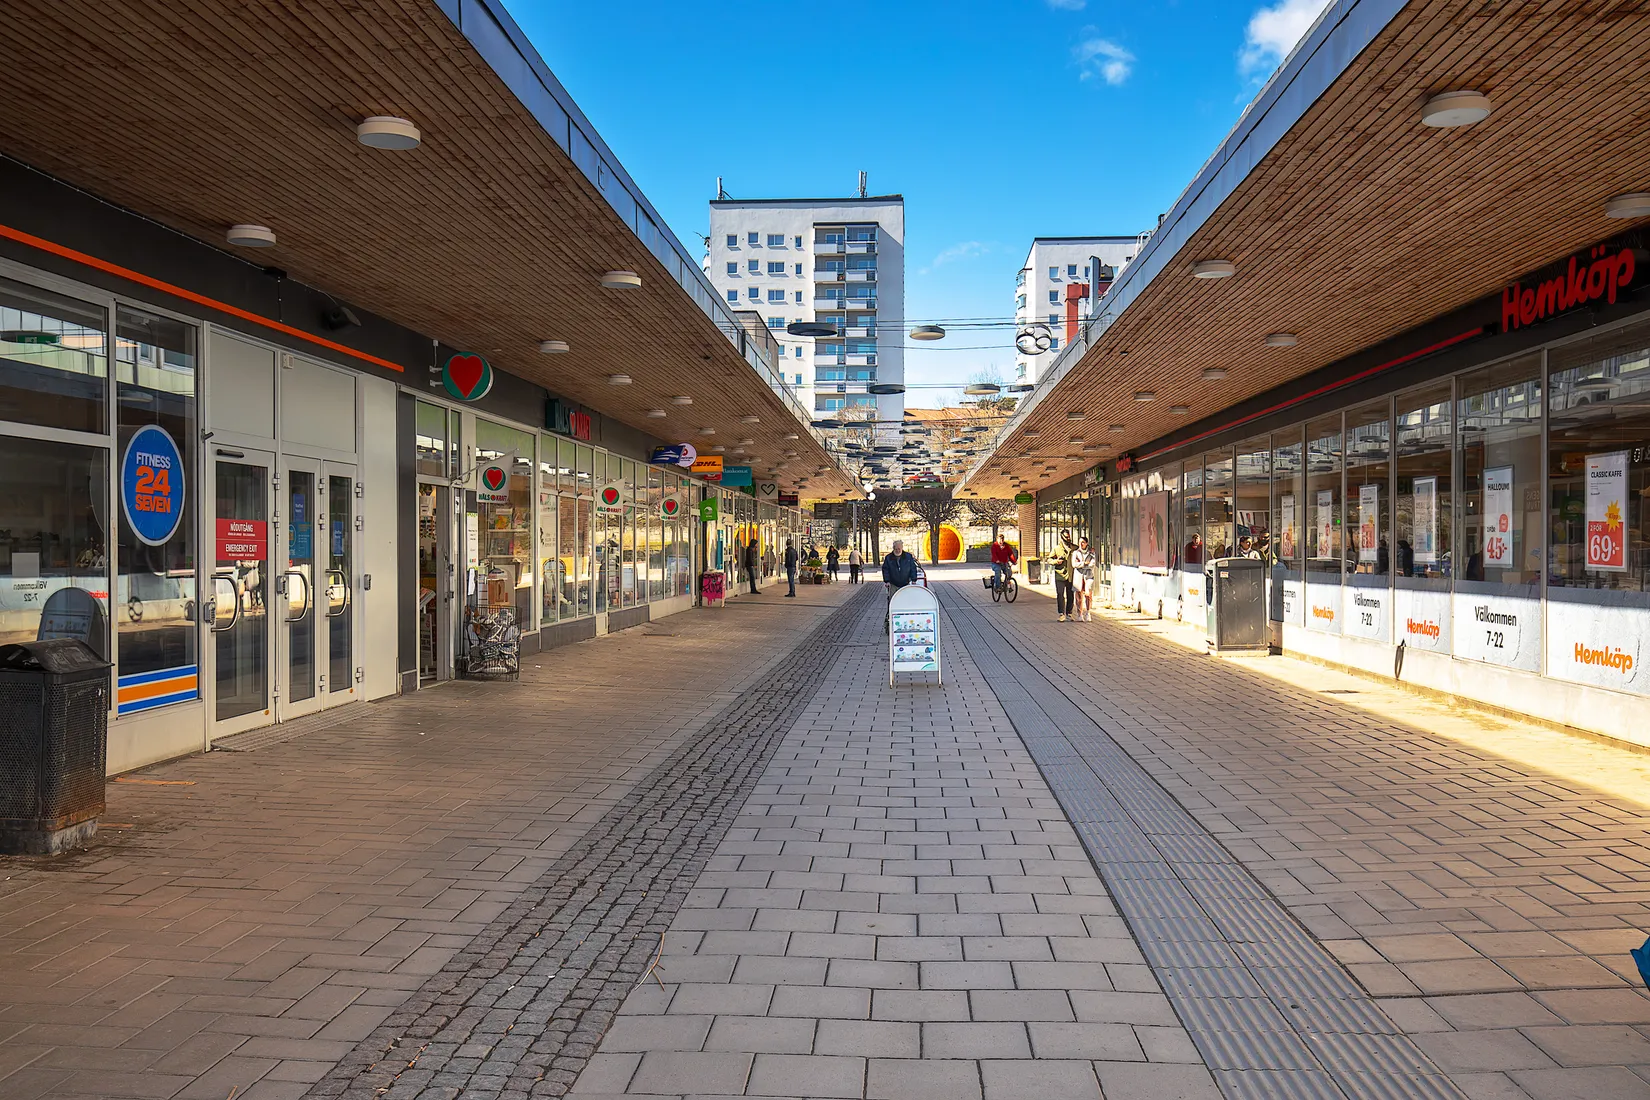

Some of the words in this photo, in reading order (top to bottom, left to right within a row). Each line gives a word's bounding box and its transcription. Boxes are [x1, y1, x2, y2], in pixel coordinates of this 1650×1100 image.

[1502, 244, 1635, 332] Hemköp
[136, 452, 171, 469] FITNESS
[135, 466, 171, 496] 24
[1488, 482, 1510, 491] HALLOUMI
[135, 494, 171, 514] SEVEN
[230, 522, 254, 532] NÖDUTGÅNG
[226, 544, 248, 552] EMERGENCY
[1590, 534, 1620, 562] 69:-
[1354, 592, 1380, 608] Välkommen
[1313, 604, 1334, 622] Hemköp
[1362, 612, 1372, 626] 7-22
[1475, 605, 1517, 626] Välkommen
[1407, 618, 1440, 640] Hemköp
[1486, 630, 1504, 648] 7-22
[1574, 642, 1633, 674] Hemköp
